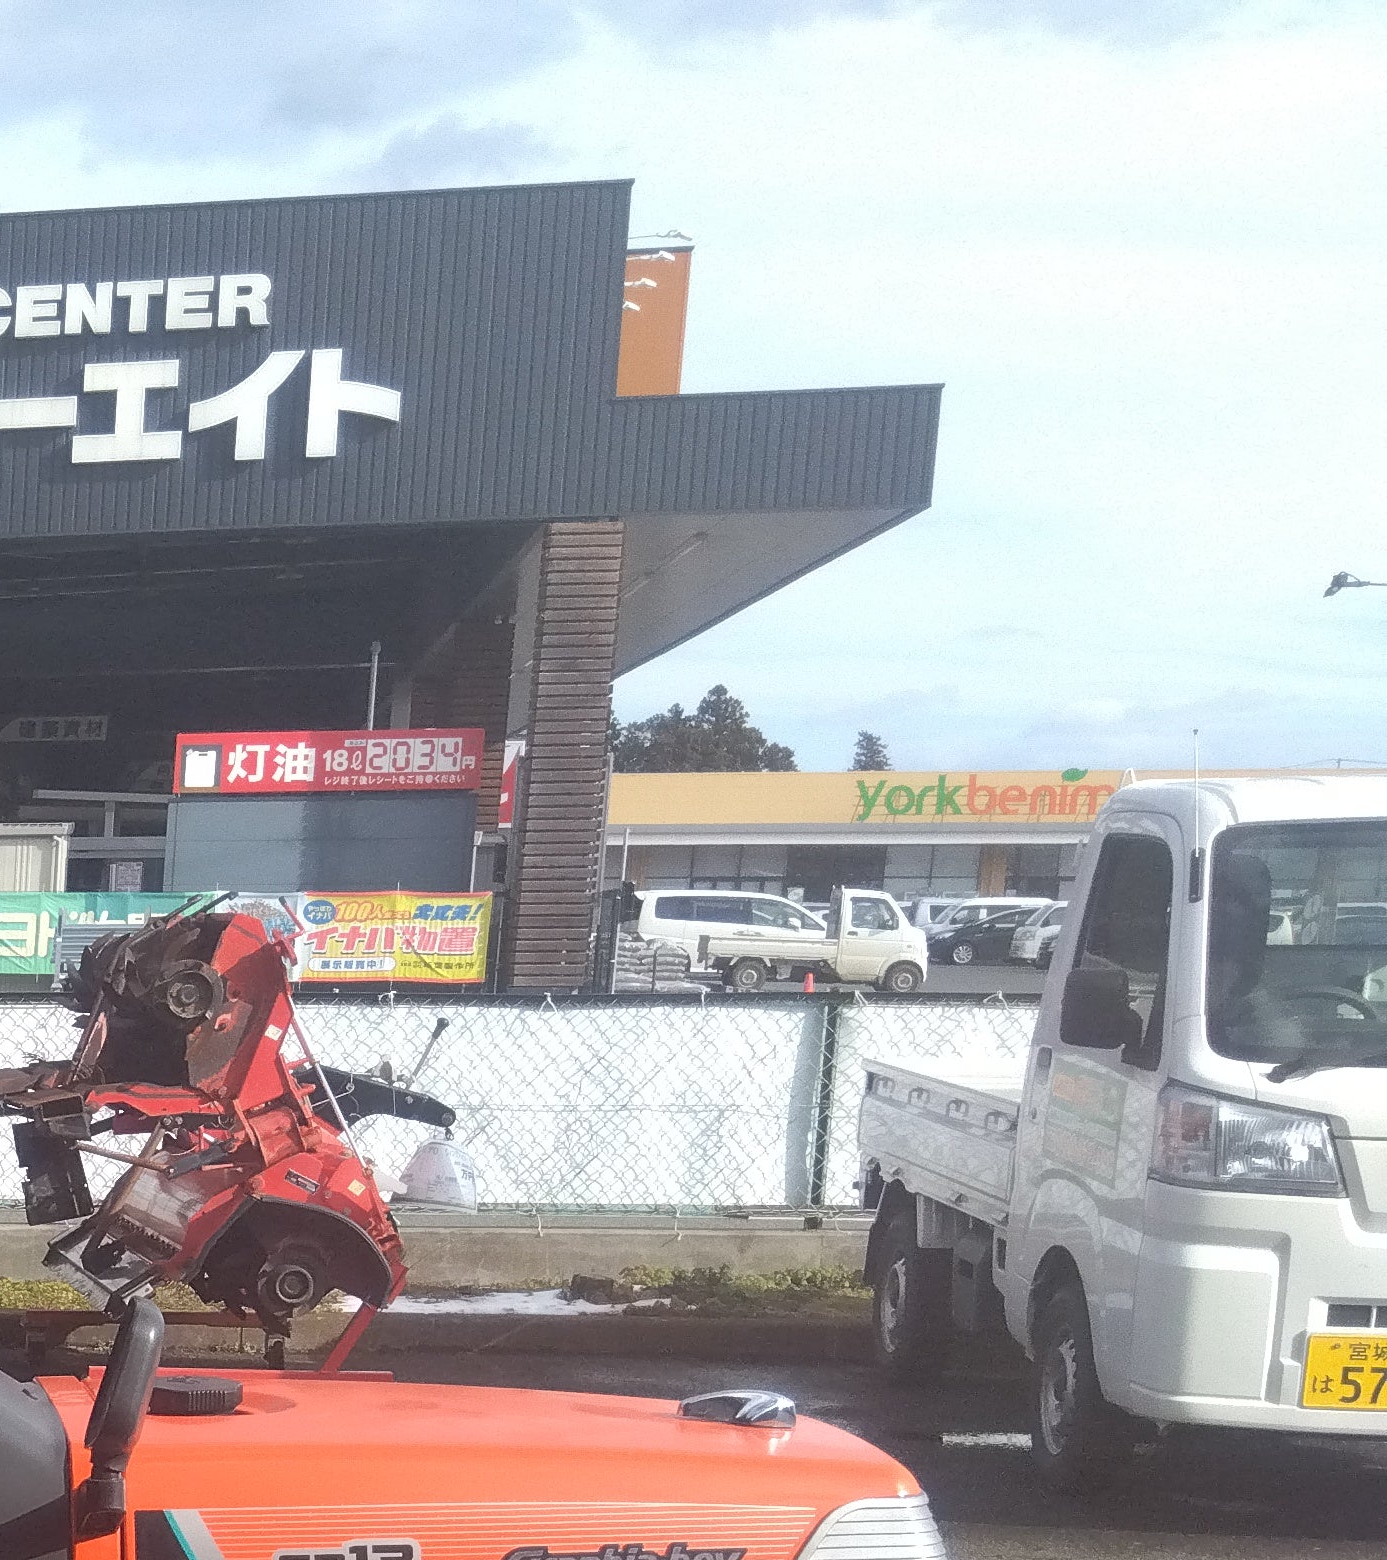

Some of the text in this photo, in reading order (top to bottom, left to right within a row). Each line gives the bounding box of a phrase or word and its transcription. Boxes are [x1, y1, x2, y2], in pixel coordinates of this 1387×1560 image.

[227, 742, 315, 783] 灯油
[304, 924, 479, 955] イナバ物置
[1312, 1366, 1387, 1405] は 57
